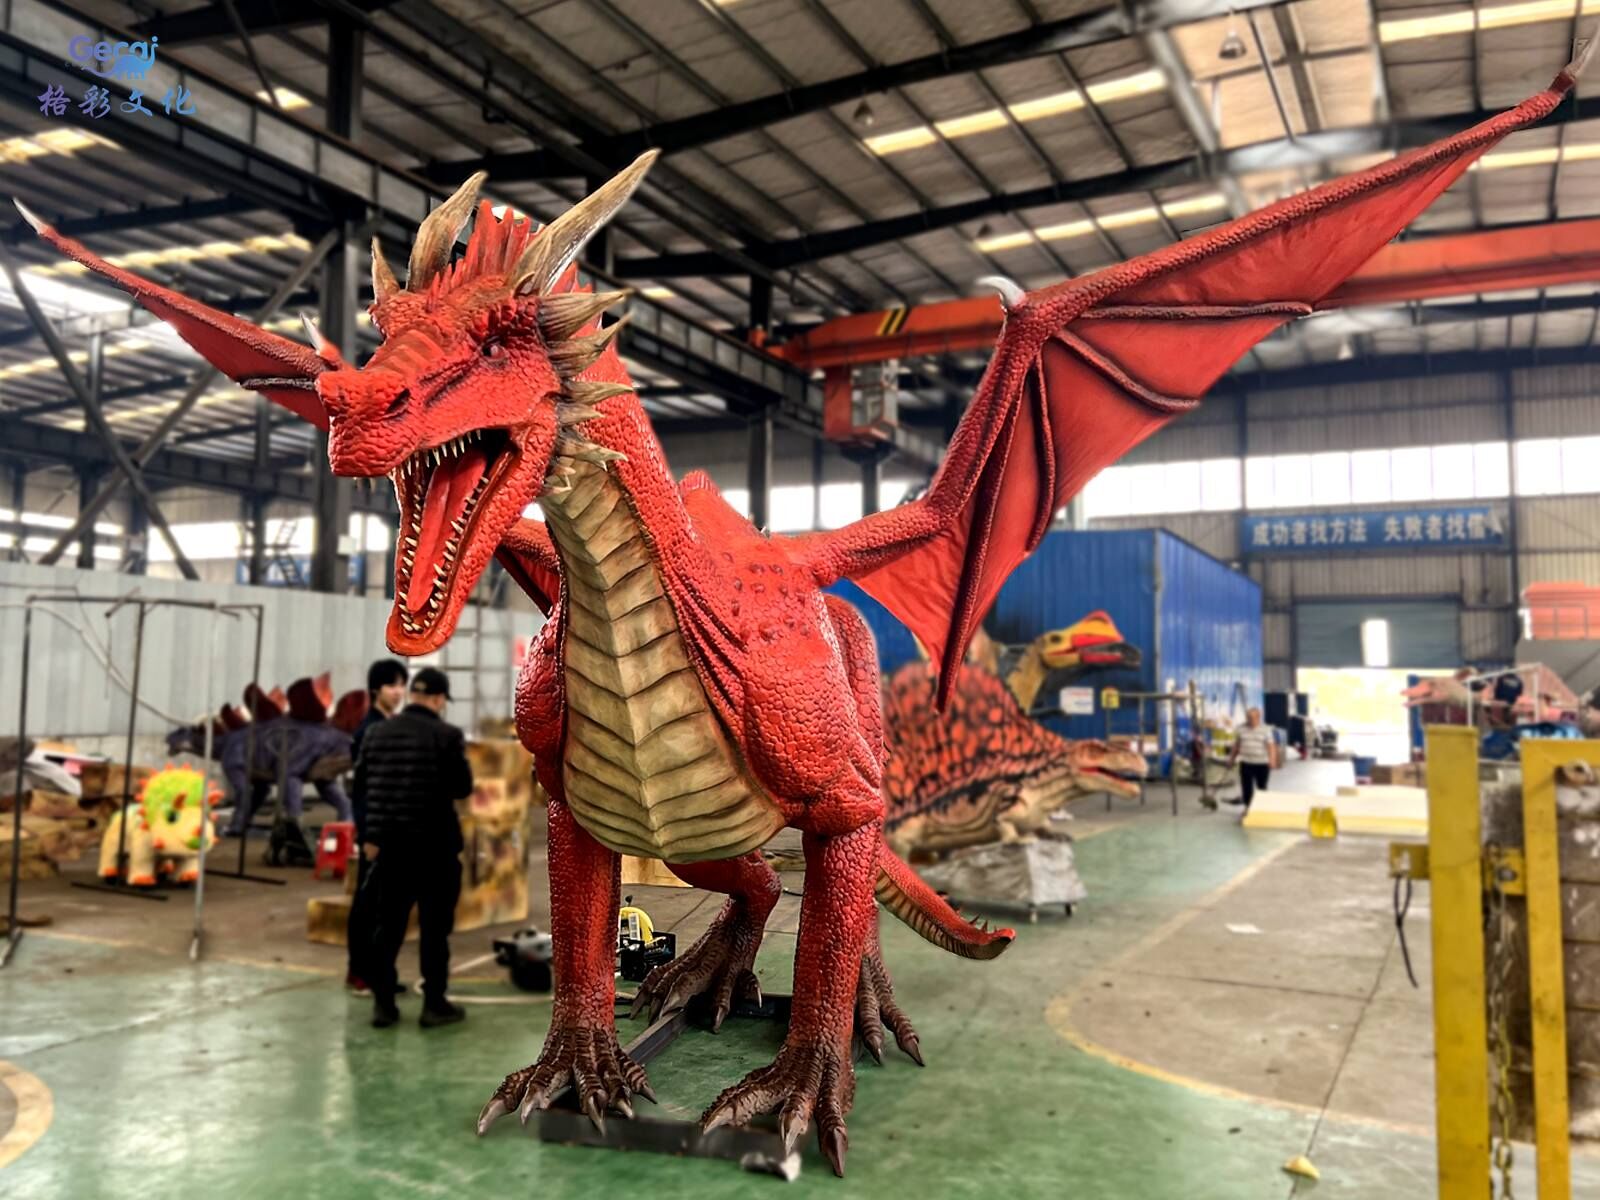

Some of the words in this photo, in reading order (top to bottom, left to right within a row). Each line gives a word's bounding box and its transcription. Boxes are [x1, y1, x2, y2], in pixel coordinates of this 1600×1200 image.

[1252, 517, 1368, 545] 成功者找方法
[1384, 513, 1487, 541] 失败者找借
